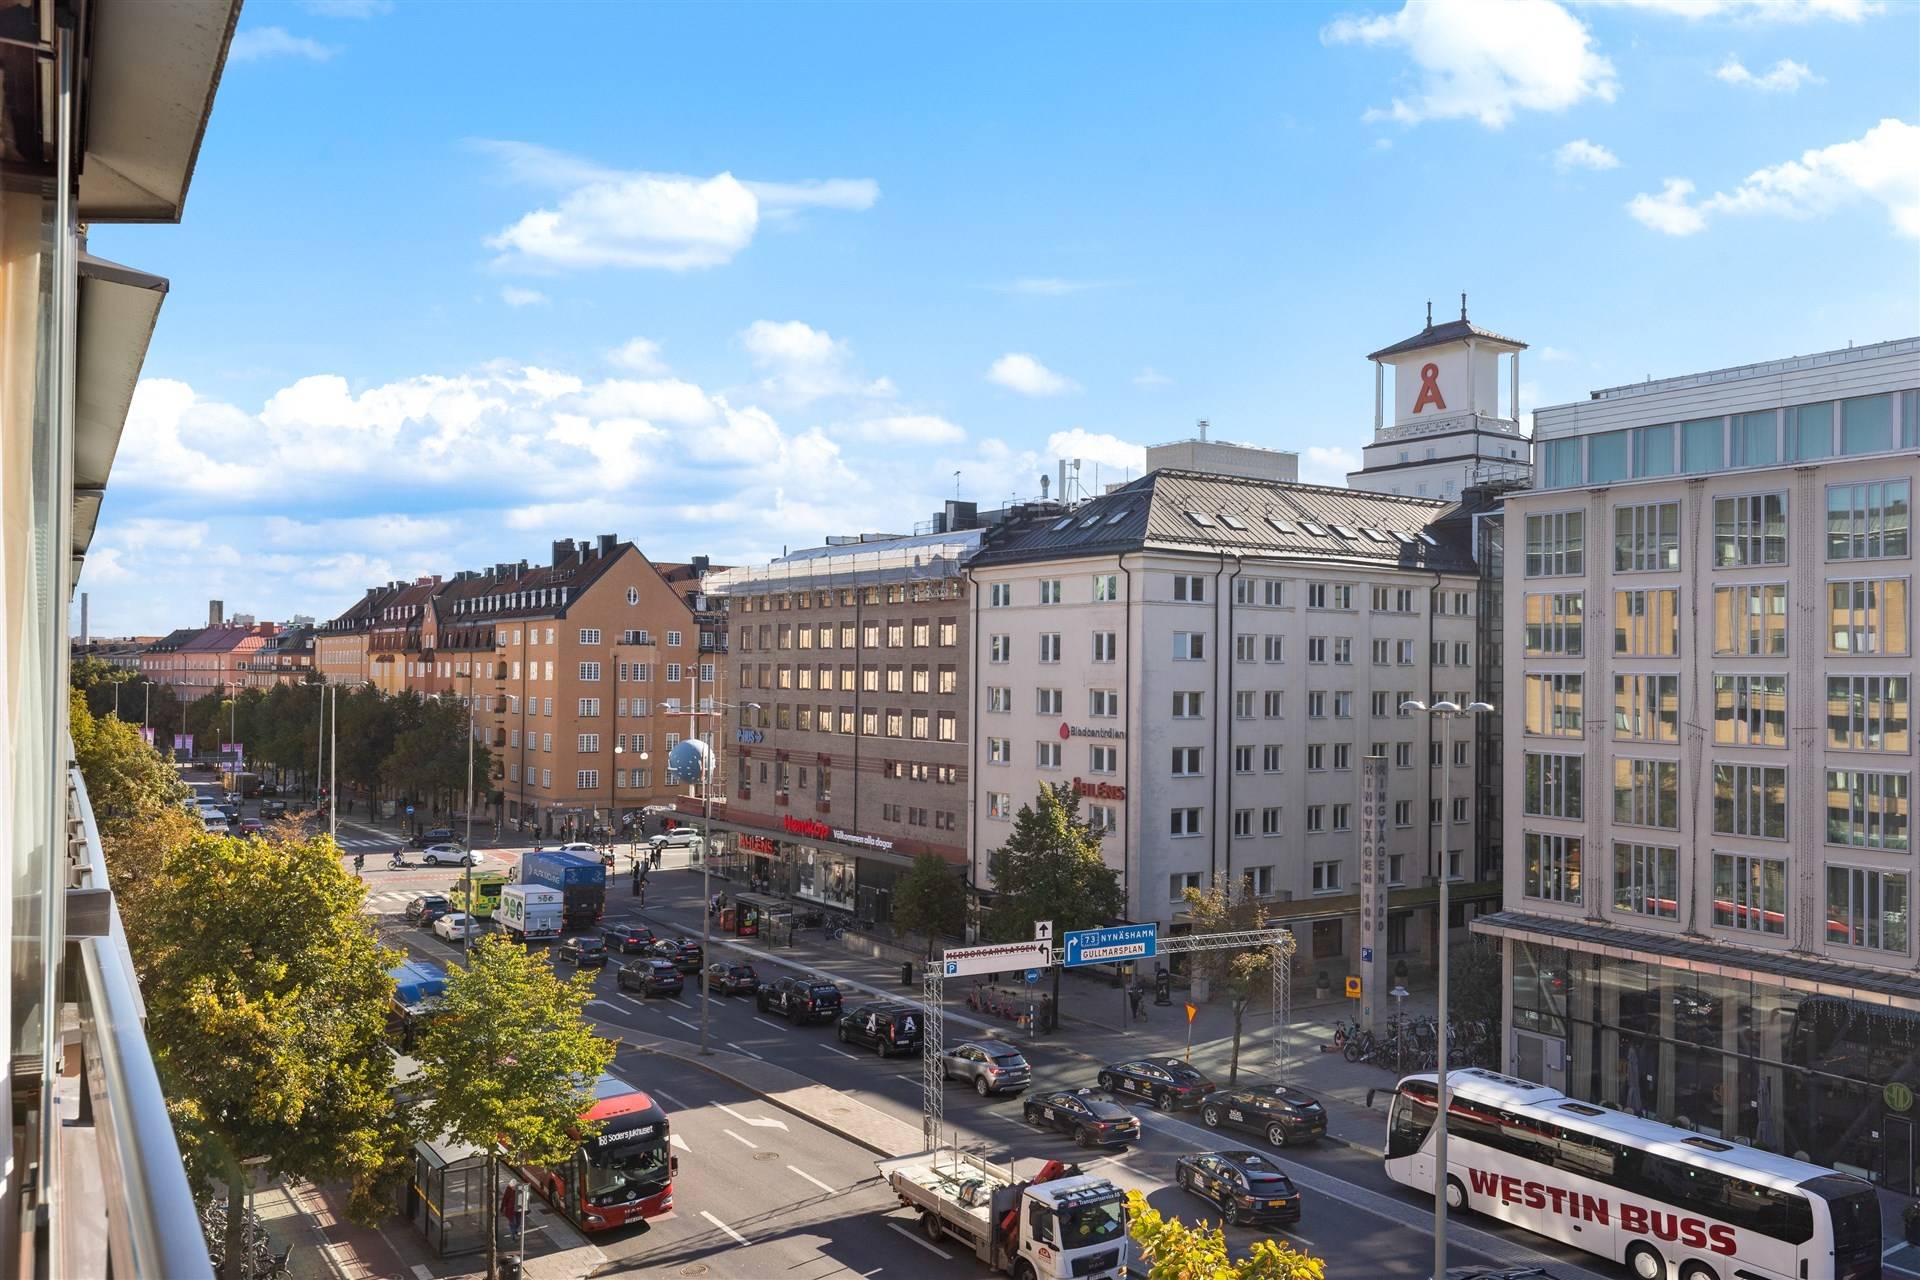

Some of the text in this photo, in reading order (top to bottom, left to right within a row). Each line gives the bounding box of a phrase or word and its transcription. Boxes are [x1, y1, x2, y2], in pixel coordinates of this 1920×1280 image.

[1412, 362, 1447, 414] Å
[1070, 726, 1125, 739] Blodcentralen
[833, 829, 864, 843] Välkommen
[864, 834, 875, 845] alla
[1377, 893, 1385, 932] 100
[1084, 929, 1154, 944] 73 NYNÄSHAMN
[945, 944, 1036, 960] MEDBORGARPLATSEN
[1083, 945, 1143, 959] GULLMARSPLAN
[1468, 1167, 1737, 1256] WESTIN BUSS
